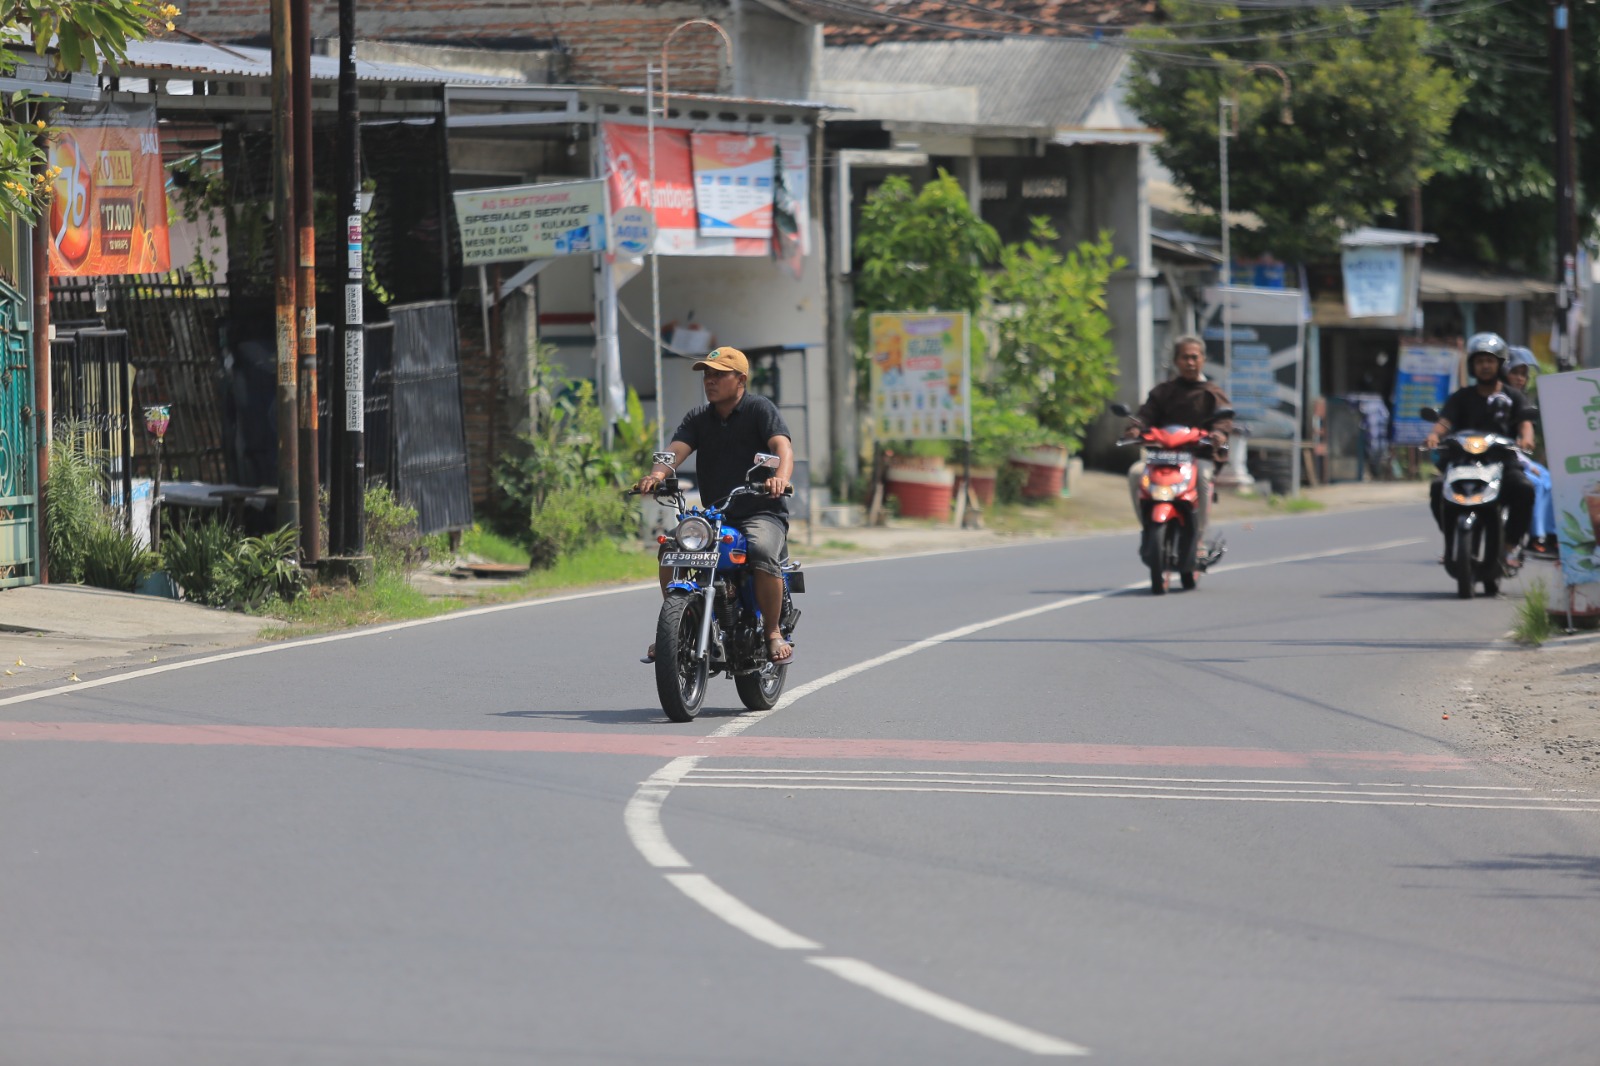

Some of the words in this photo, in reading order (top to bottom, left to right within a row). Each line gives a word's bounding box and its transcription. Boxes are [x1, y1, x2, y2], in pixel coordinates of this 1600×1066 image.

[96, 155, 131, 180] ROYAL
[464, 210, 531, 225] SPESIALIS
[534, 204, 590, 219] SERVICE
[464, 228, 475, 237] TV
[478, 225, 497, 235] LED
[509, 223, 529, 233] LCD
[541, 218, 580, 230] KULKAS
[465, 238, 496, 248] MESIN
[499, 235, 522, 245] CUCI
[465, 248, 494, 259] KIPAS
[497, 245, 528, 256] ANGIN
[346, 330, 353, 349] WC
